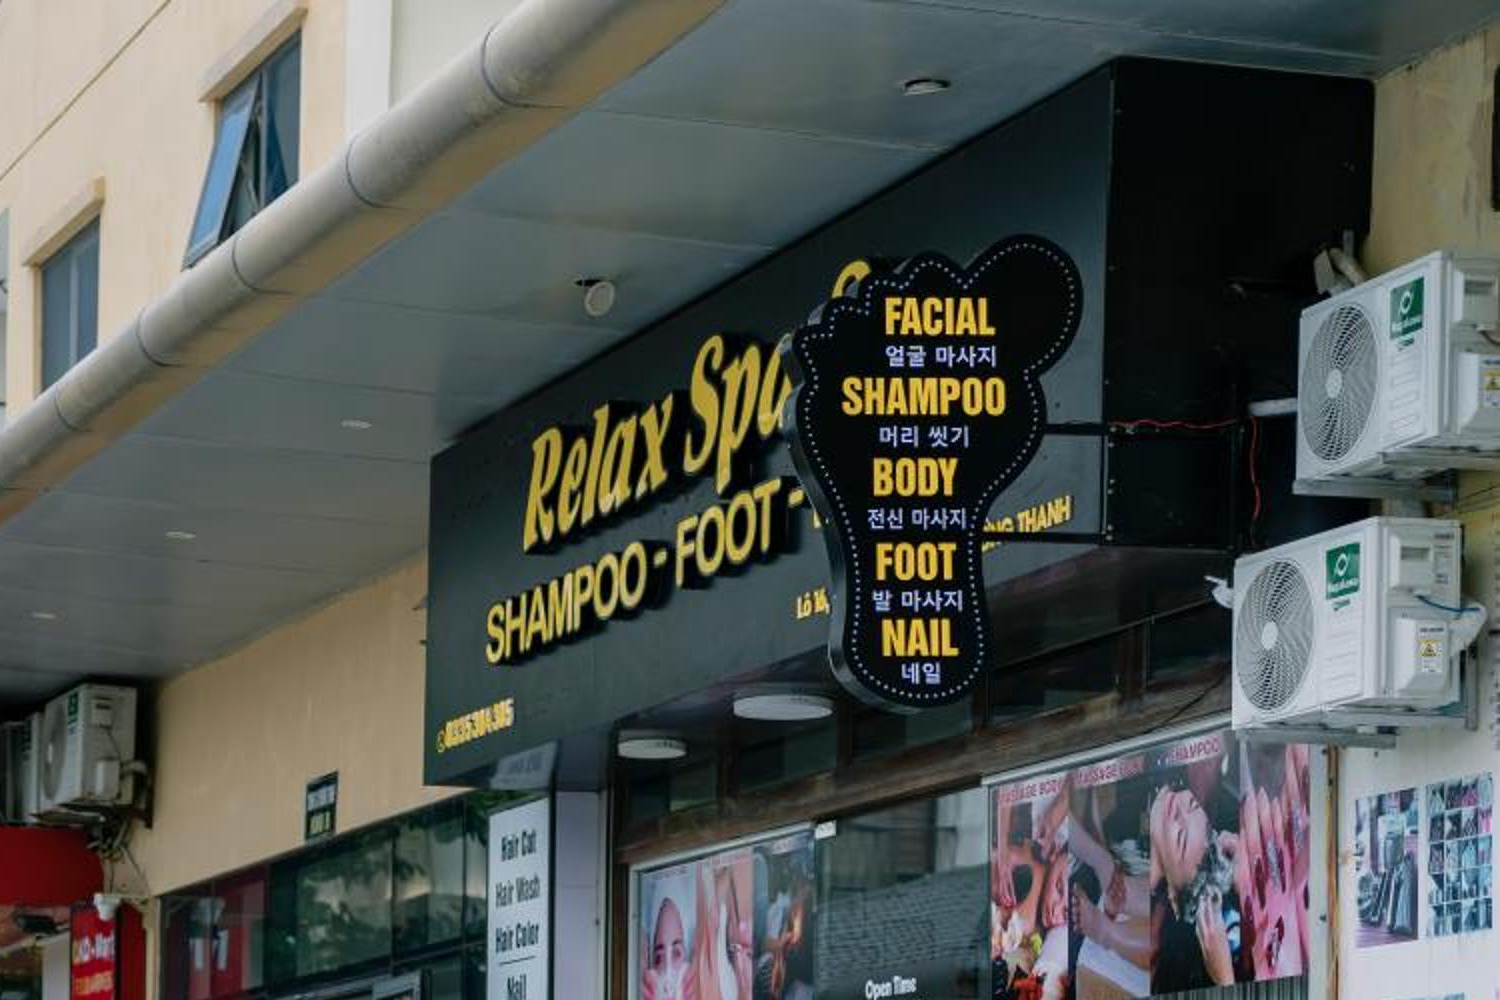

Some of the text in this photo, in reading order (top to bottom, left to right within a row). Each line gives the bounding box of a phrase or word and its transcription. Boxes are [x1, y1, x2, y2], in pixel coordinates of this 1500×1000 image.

[884, 297, 996, 336] FACIAL
[886, 345, 997, 368] 얼굴 마사지
[841, 376, 1006, 416] SHAMPOO
[879, 425, 969, 448] 머리 씻기
[523, 393, 673, 554] Relax
[873, 457, 958, 498] BODY
[867, 507, 966, 530] 전신 마사지
[1017, 495, 1072, 533] THANH
[486, 541, 647, 664] SHAMPOO
[676, 479, 781, 588] FOOT
[876, 542, 957, 581] FOOT
[872, 589, 963, 612] 발 마사지
[881, 618, 959, 657] NAIL
[901, 662, 941, 685] 네일
[502, 828, 537, 861] Hair Cut
[496, 872, 539, 908] Hair Wash
[496, 920, 539, 954] Hair Color
